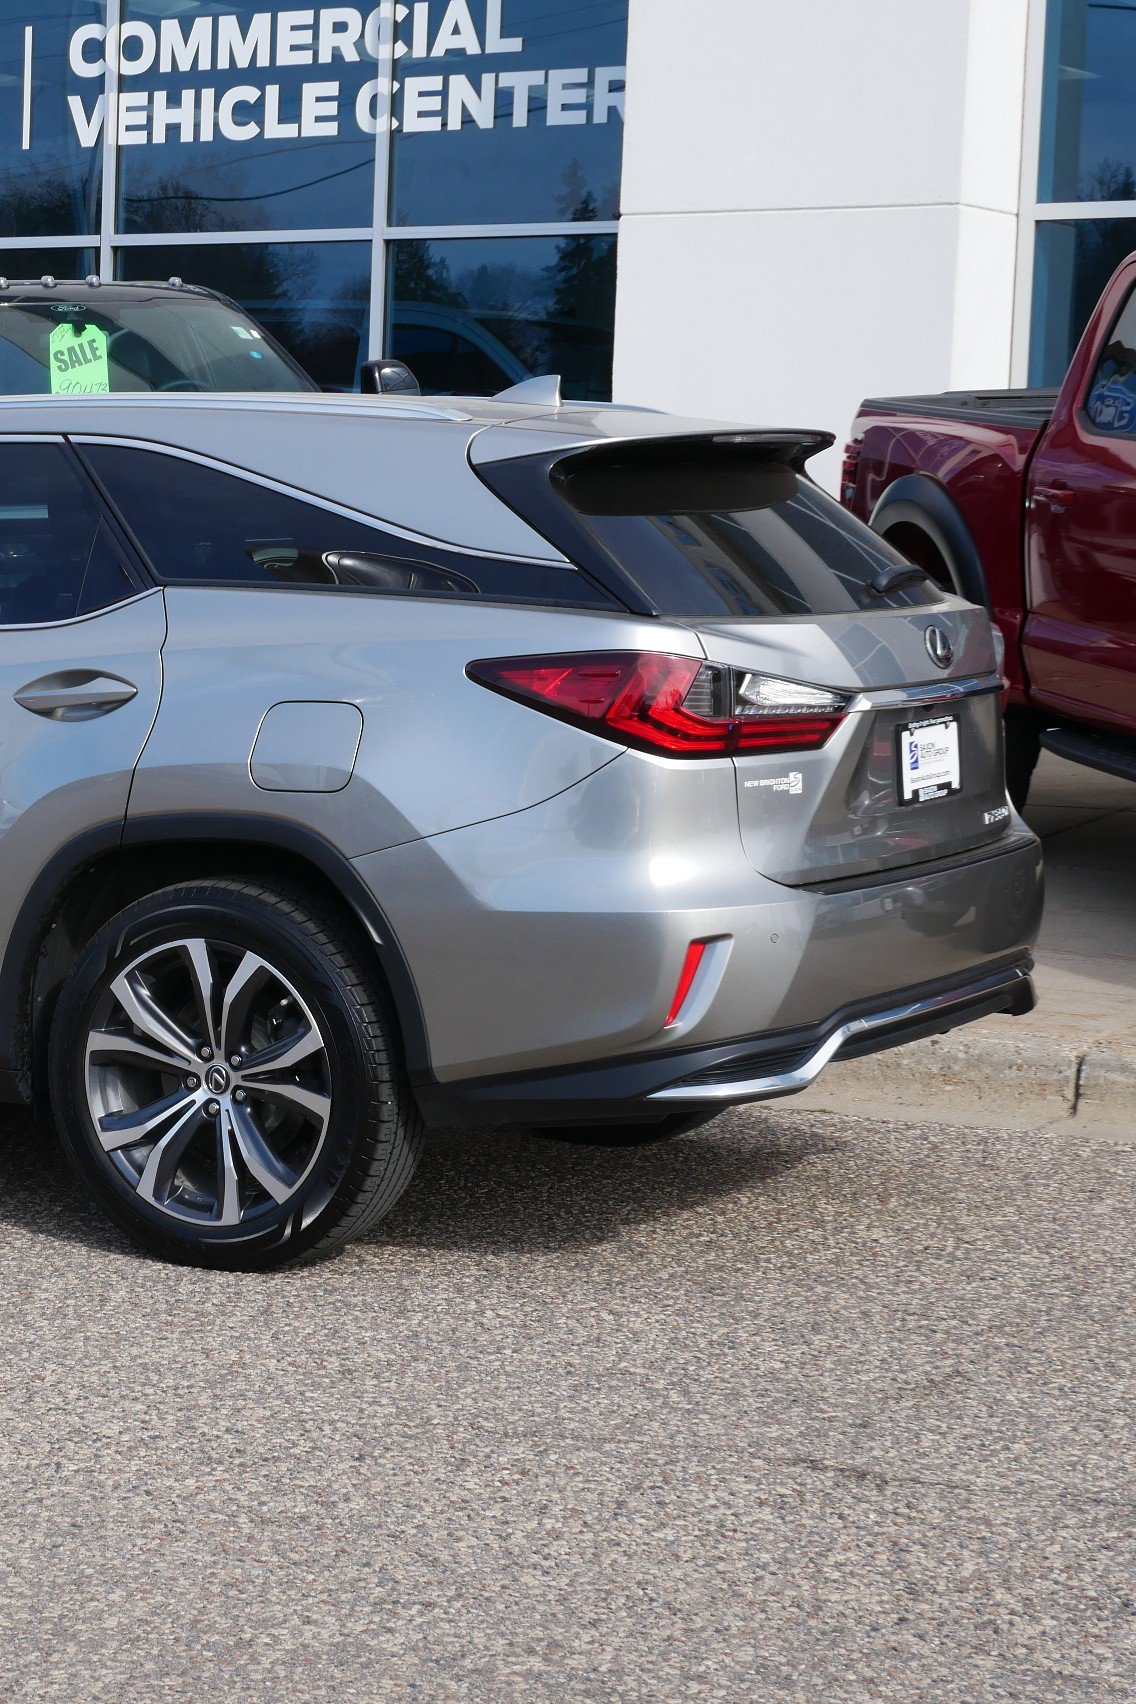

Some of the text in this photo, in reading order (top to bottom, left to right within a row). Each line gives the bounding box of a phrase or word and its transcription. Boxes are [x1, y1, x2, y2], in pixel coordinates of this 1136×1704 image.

[68, 0, 524, 78] COMMERCIAL
[67, 66, 626, 148] VEHICLE CENTER
[52, 338, 103, 373] SALE
[744, 780, 759, 788] NEW
